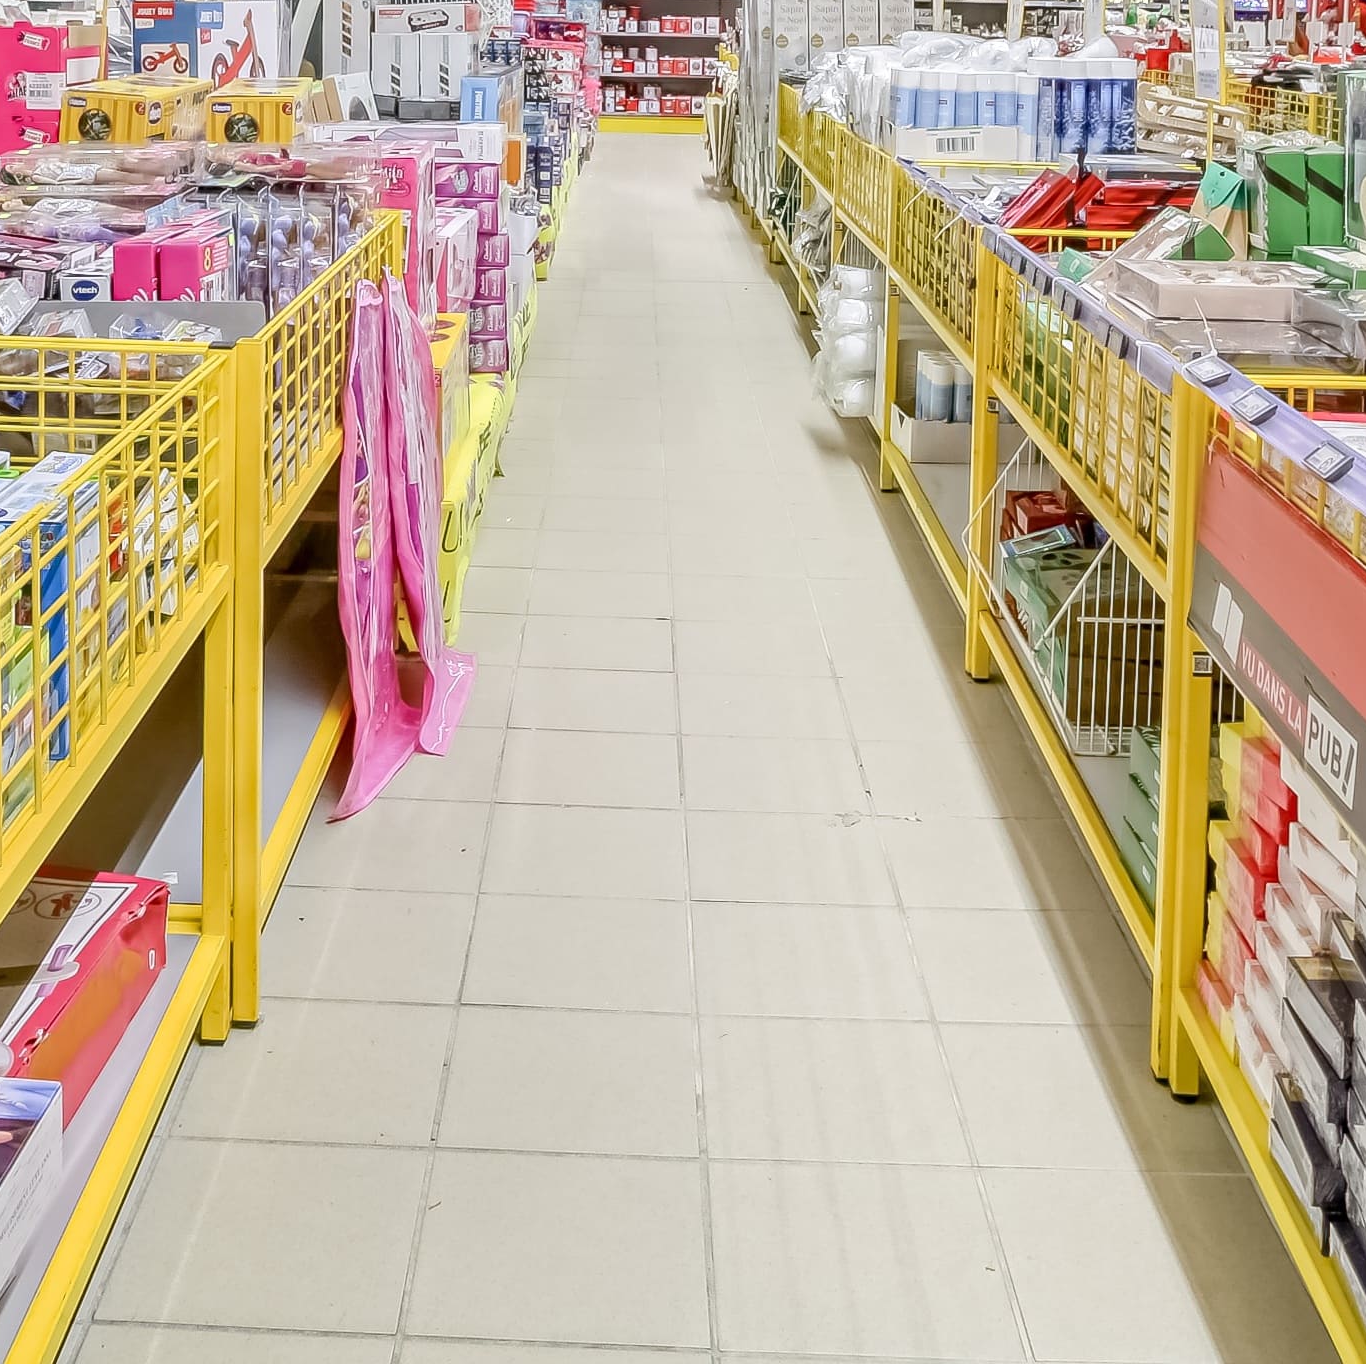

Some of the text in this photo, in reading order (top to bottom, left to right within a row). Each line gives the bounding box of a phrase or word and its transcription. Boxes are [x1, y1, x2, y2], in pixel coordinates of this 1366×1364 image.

[72, 286, 99, 294] vtech
[1242, 642, 1355, 797] VU DANS LA PUB!
